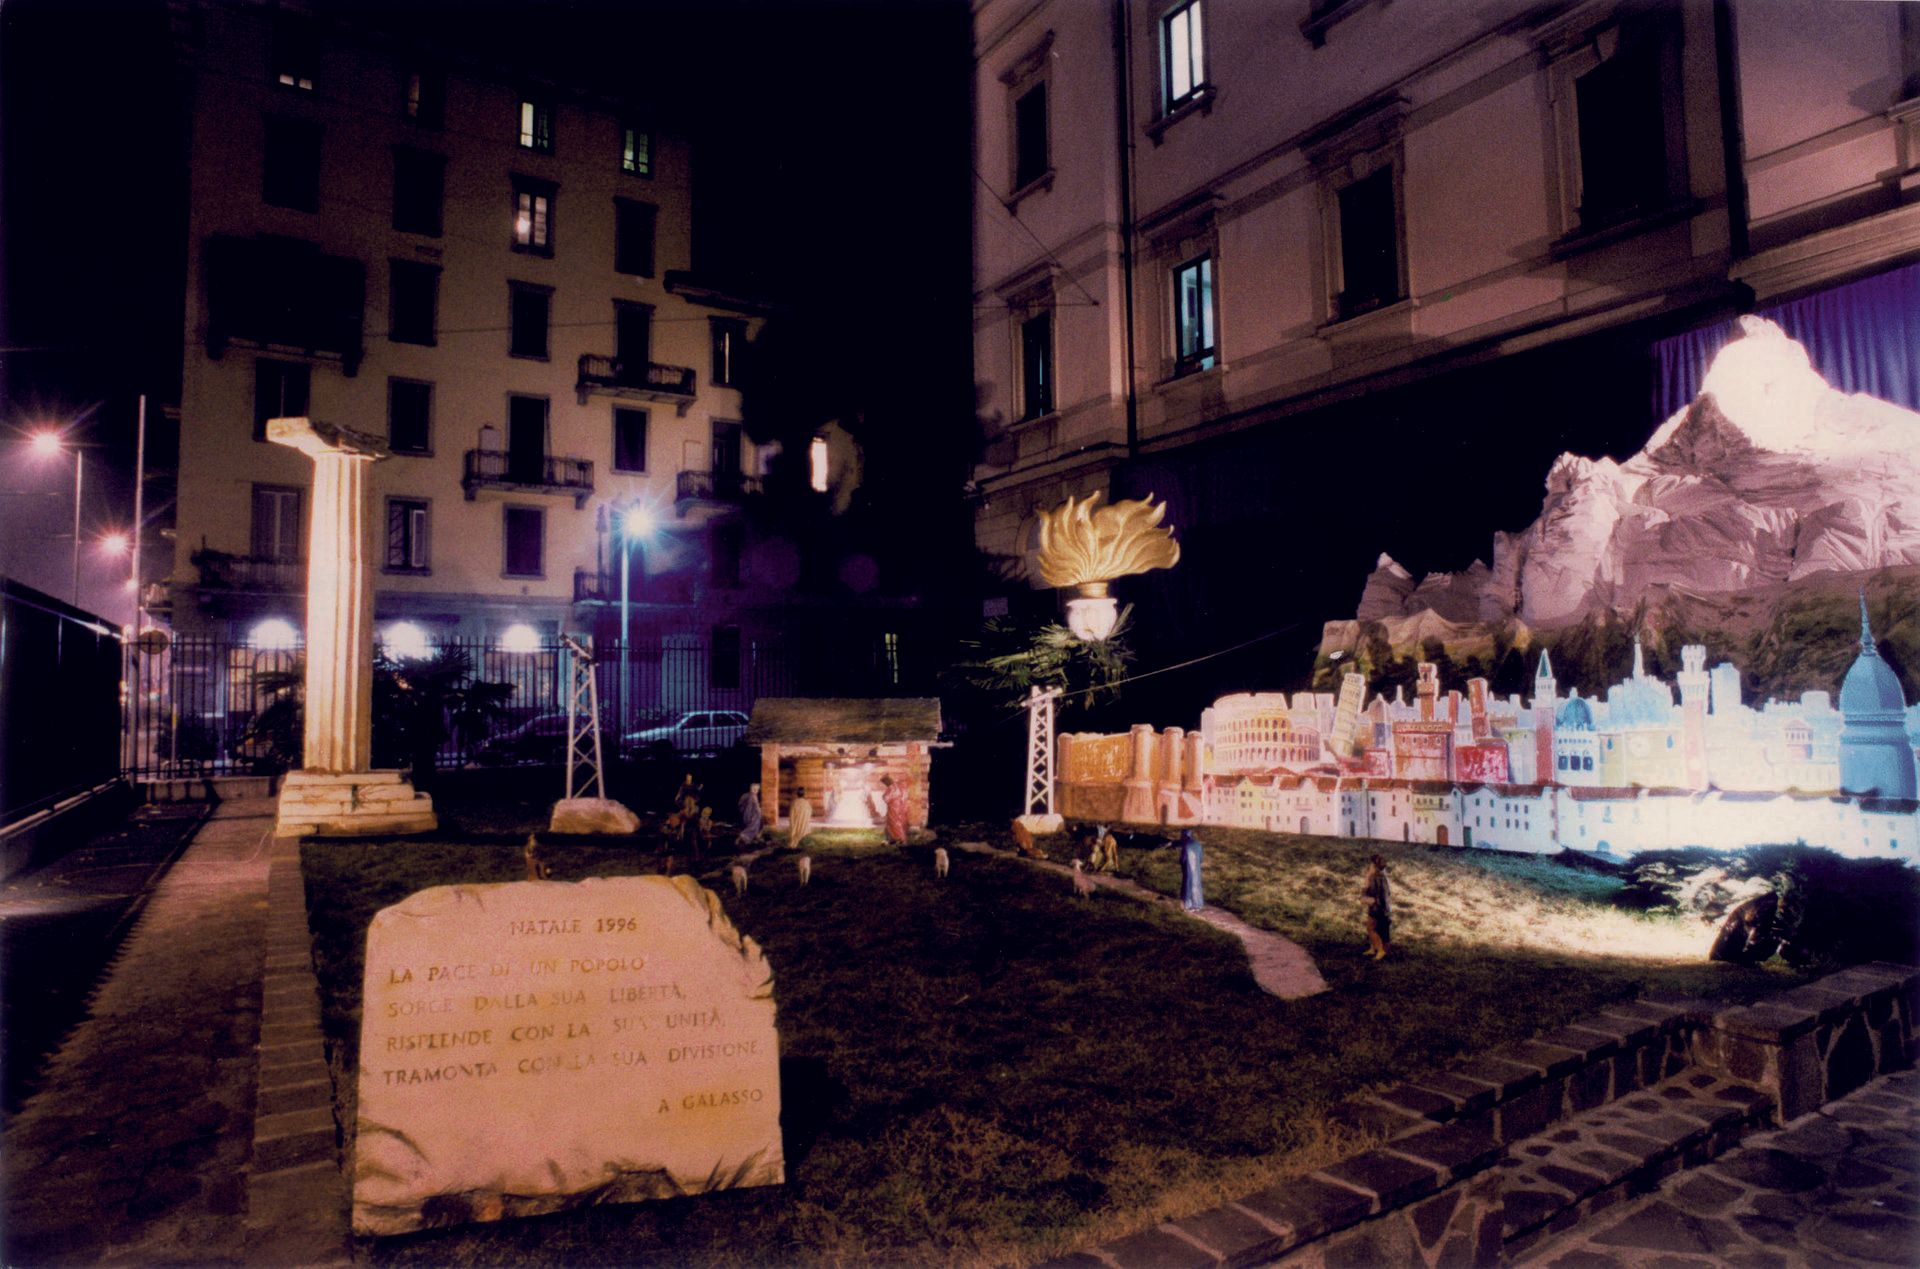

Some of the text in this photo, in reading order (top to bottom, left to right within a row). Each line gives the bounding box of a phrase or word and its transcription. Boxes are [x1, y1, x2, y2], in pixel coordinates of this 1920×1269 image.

[510, 917, 637, 936] NATALE 1996
[389, 957, 644, 985] LA PACE DI UN POPOLO
[474, 993, 538, 1012] DALLA
[551, 989, 587, 1006] SUA
[510, 1024, 555, 1043] CON
[567, 1023, 591, 1039] LA
[383, 1062, 498, 1085] TRAMONTA
[568, 1053, 596, 1071] LA
[612, 1051, 648, 1066] SUA
[682, 1088, 764, 1110] GALASSO
